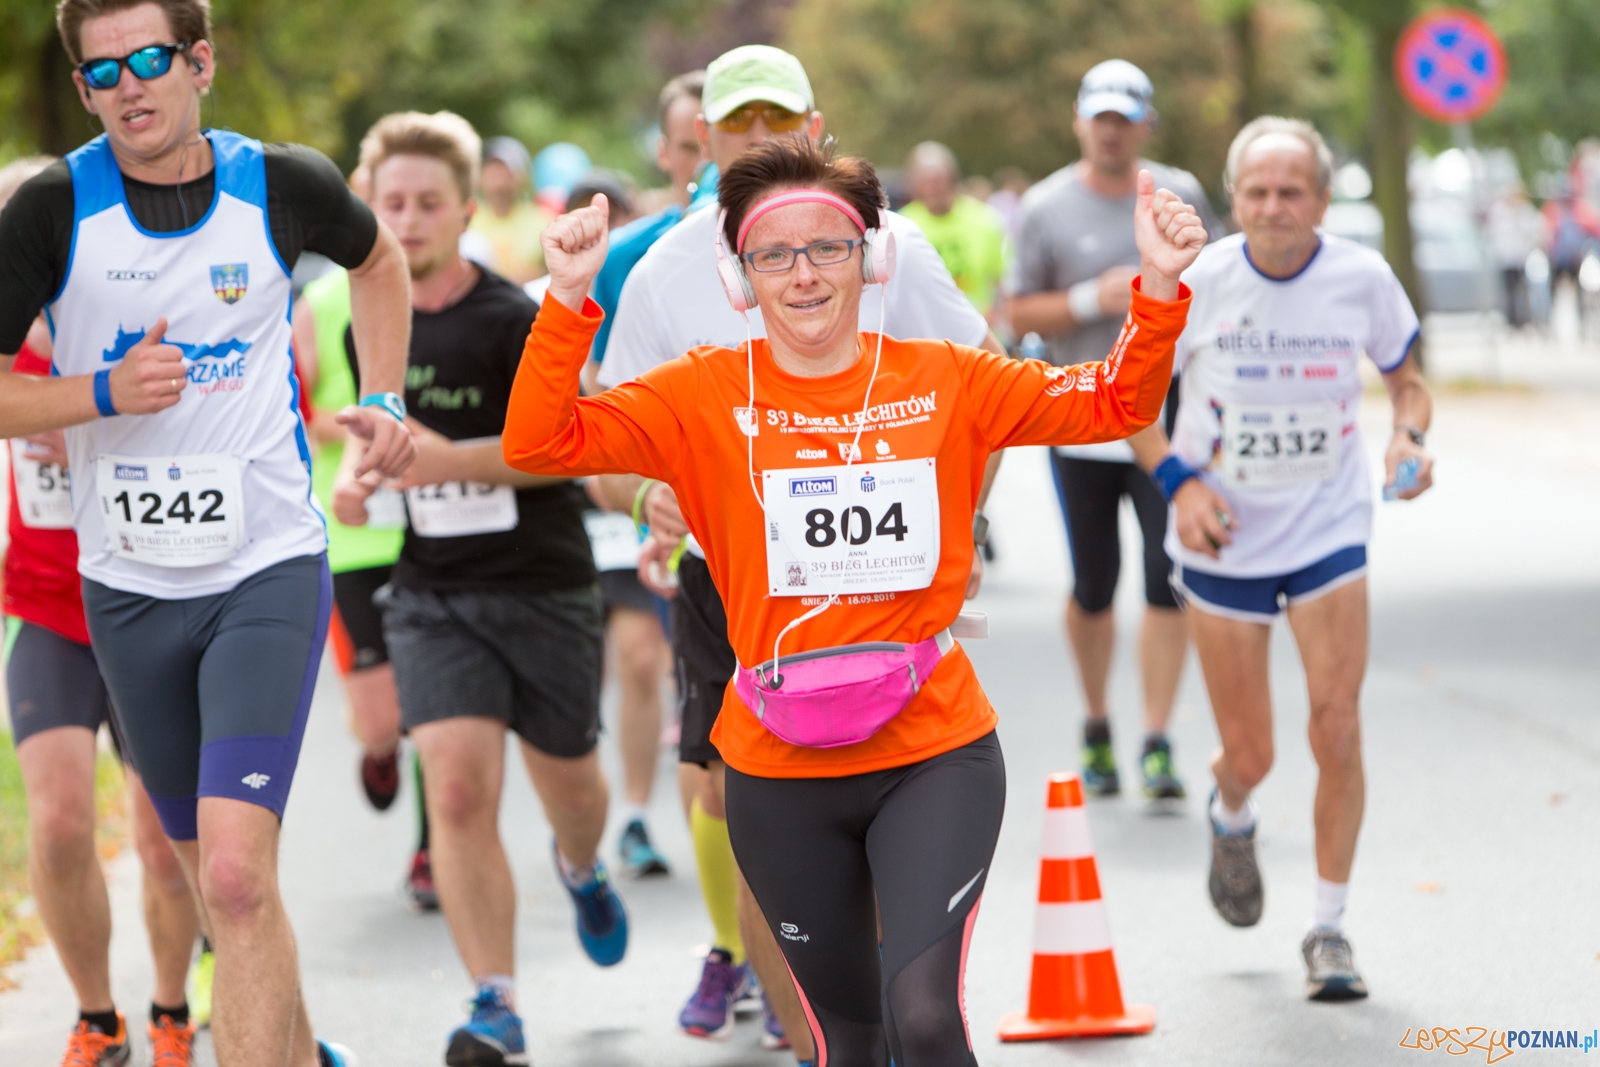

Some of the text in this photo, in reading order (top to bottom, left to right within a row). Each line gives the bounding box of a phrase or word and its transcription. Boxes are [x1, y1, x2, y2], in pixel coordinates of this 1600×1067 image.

[766, 390, 936, 427] 39 BIEG LECHITÓW
[850, 424, 876, 433] LEARZY
[1238, 430, 1327, 458] 2332
[880, 476, 915, 486] Bank Polski
[114, 489, 226, 524] 1242
[805, 502, 909, 548] 804
[811, 552, 927, 574] 39 BIEG LECHITÓW
[801, 592, 895, 606] GNIEZO, 18.09.2016
[241, 772, 271, 789] 4F
